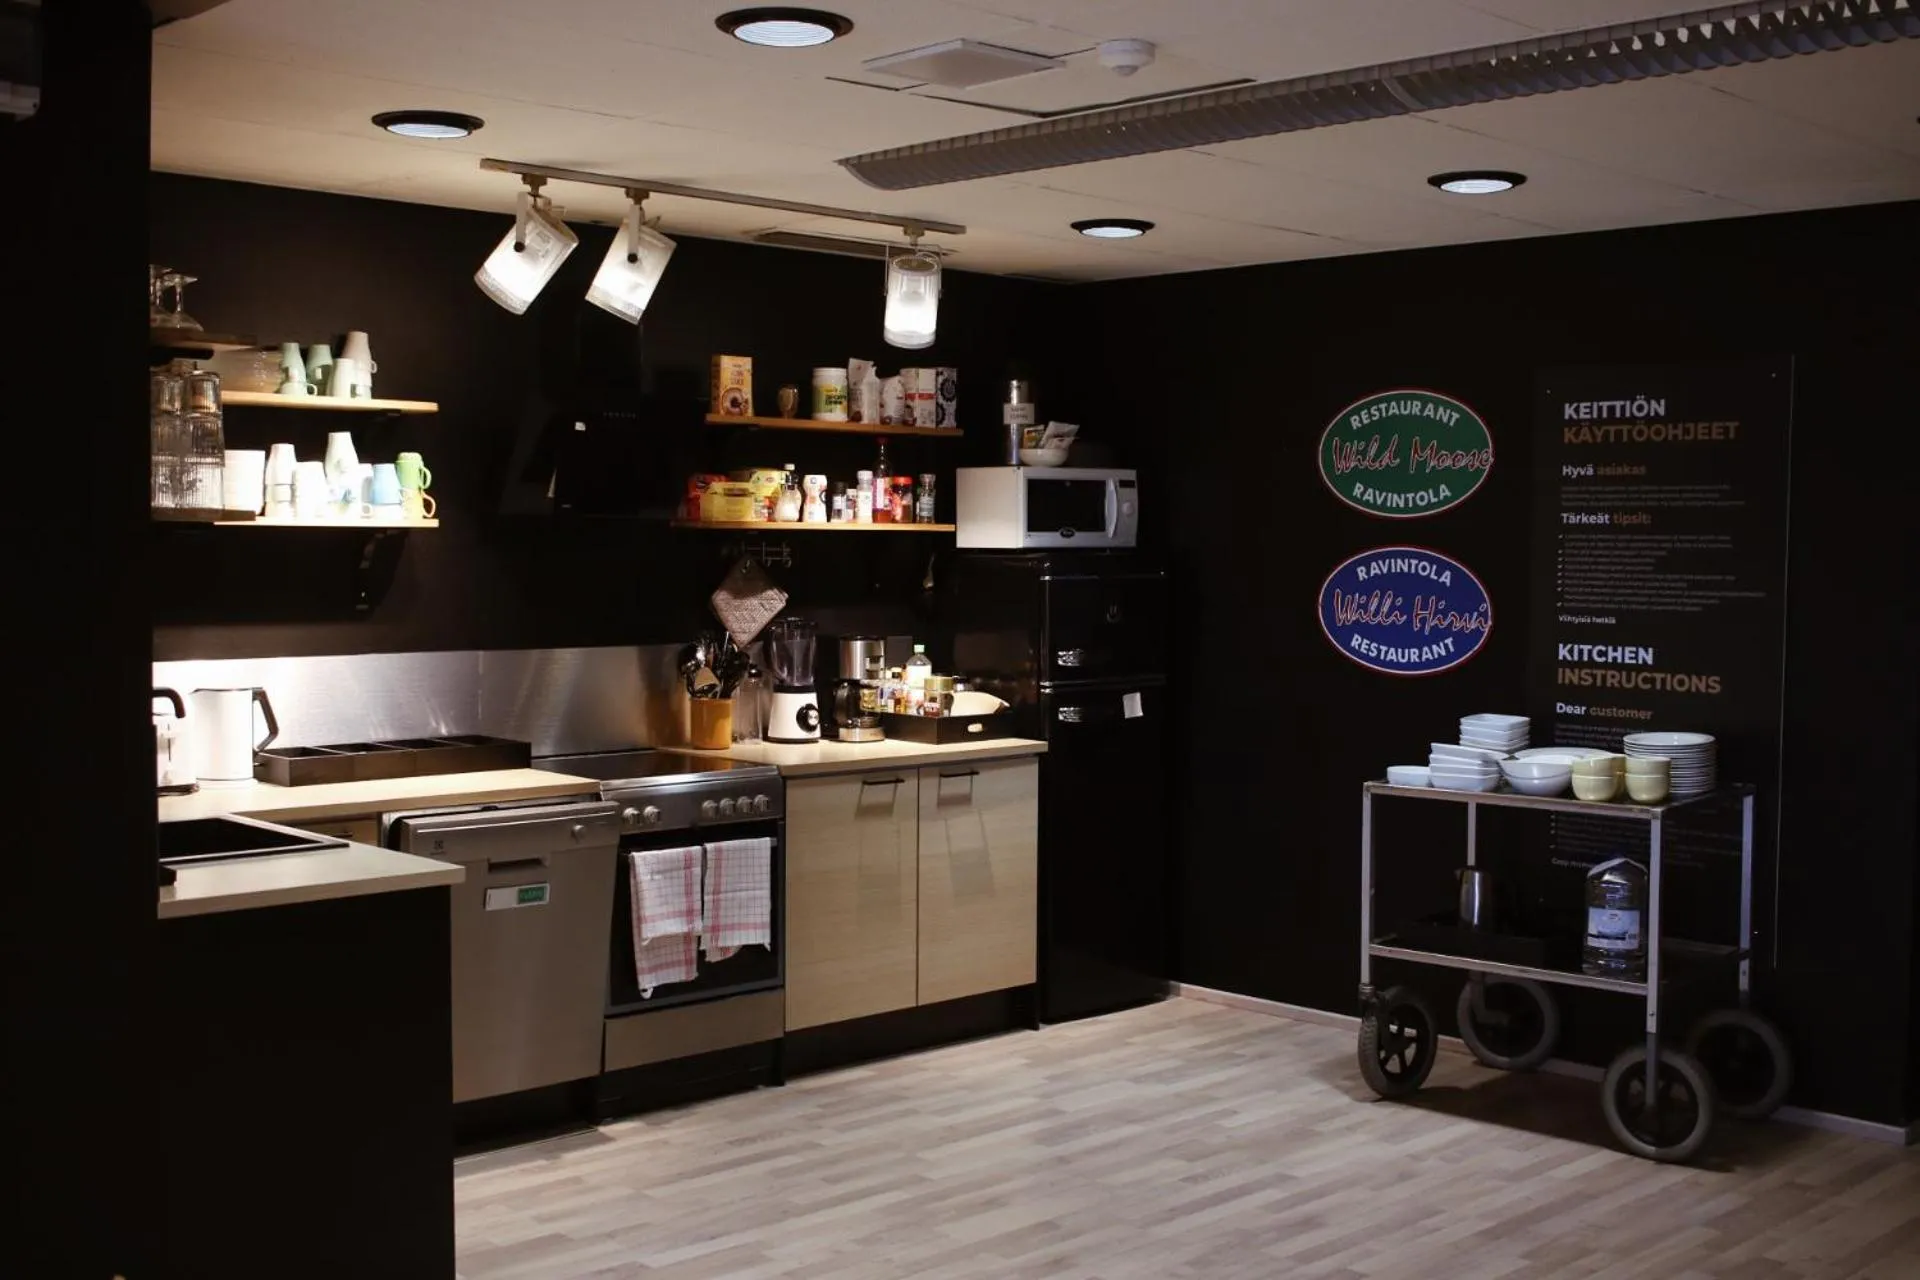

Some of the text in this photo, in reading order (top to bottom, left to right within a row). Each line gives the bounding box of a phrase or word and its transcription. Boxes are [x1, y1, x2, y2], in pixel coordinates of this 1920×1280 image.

[1349, 400, 1461, 431] RESTAURANT
[1564, 394, 1666, 420] KEITTIÖN
[1563, 420, 1740, 444] KÄYTTÖOHJEET
[1332, 433, 1494, 475] Wild Moose
[1562, 463, 1647, 479] Hyvä asiakas
[1352, 482, 1451, 508] RAVINTOLA
[1560, 511, 1611, 525] Tärkeät
[1355, 558, 1453, 587] RAVINTOLA
[1332, 588, 1492, 636] Willi Hirvi
[1350, 633, 1456, 663] RESTAURANT
[1558, 642, 1654, 665] KITCHEN
[1557, 667, 1721, 695] INSTRUCTIONS
[1556, 701, 1654, 721] Dear customer
